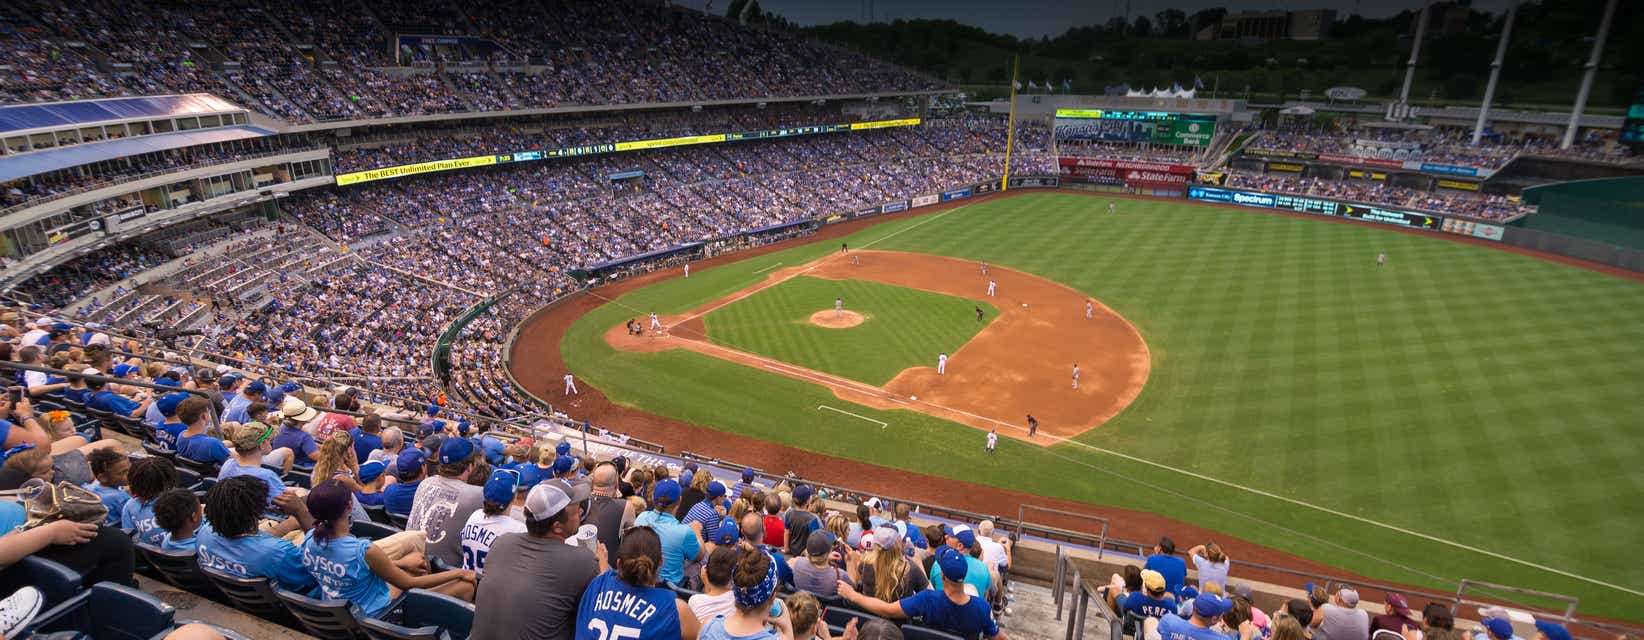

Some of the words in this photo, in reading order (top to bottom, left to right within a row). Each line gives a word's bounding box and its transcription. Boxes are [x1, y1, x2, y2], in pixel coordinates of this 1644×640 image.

[365, 172, 379, 180] The
[380, 168, 399, 177] BEST
[400, 161, 437, 174] Unlimited
[437, 162, 454, 170] Plan
[1234, 193, 1273, 205] Spectrum
[199, 544, 247, 575] Sysco
[303, 547, 346, 578] Sysco
[594, 590, 657, 624] HOSMER
[1142, 605, 1172, 617] PERE
